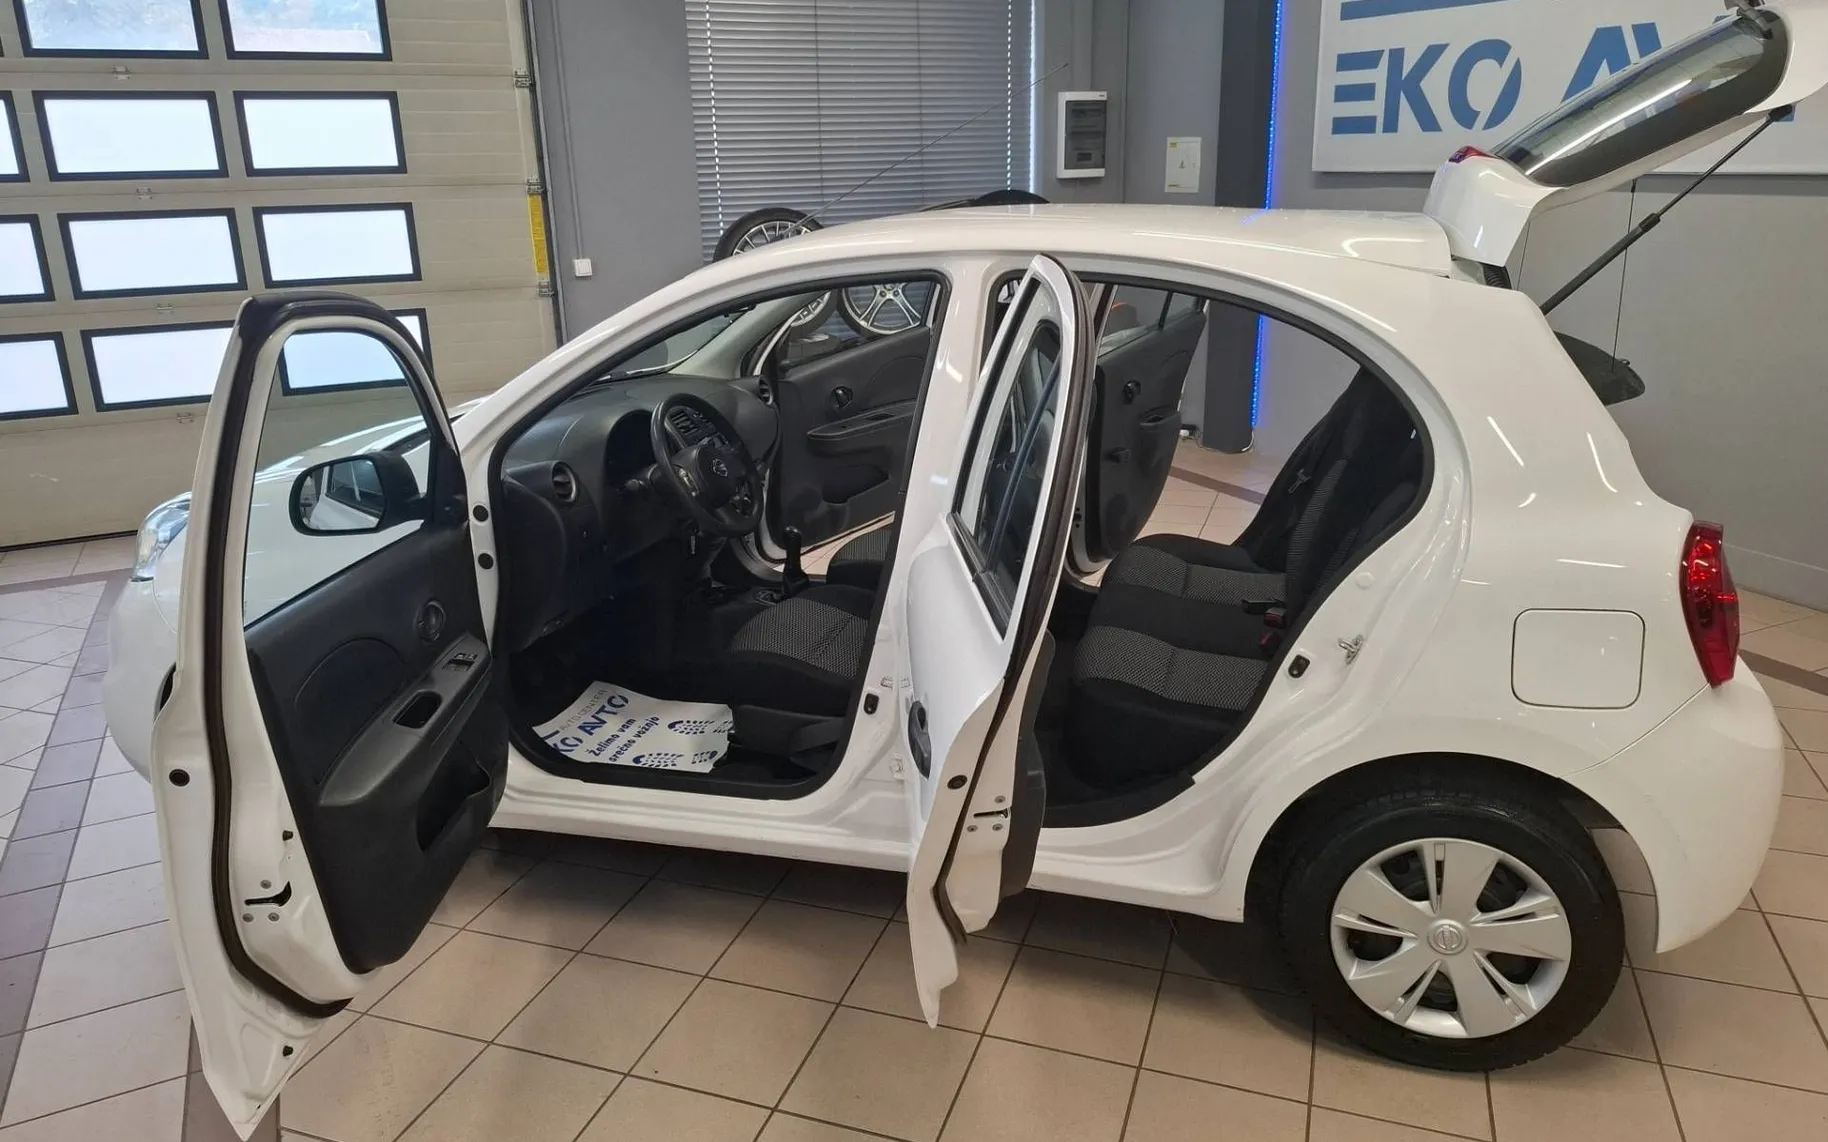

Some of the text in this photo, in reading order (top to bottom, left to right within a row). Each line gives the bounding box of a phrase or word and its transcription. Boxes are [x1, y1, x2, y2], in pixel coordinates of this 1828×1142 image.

[1331, 39, 1522, 135] EKO
[551, 694, 629, 753] KO AVTO
[579, 689, 607, 715] CENTER
[586, 718, 637, 757] Želimo vam
[608, 715, 660, 763] srečno vožnjo
